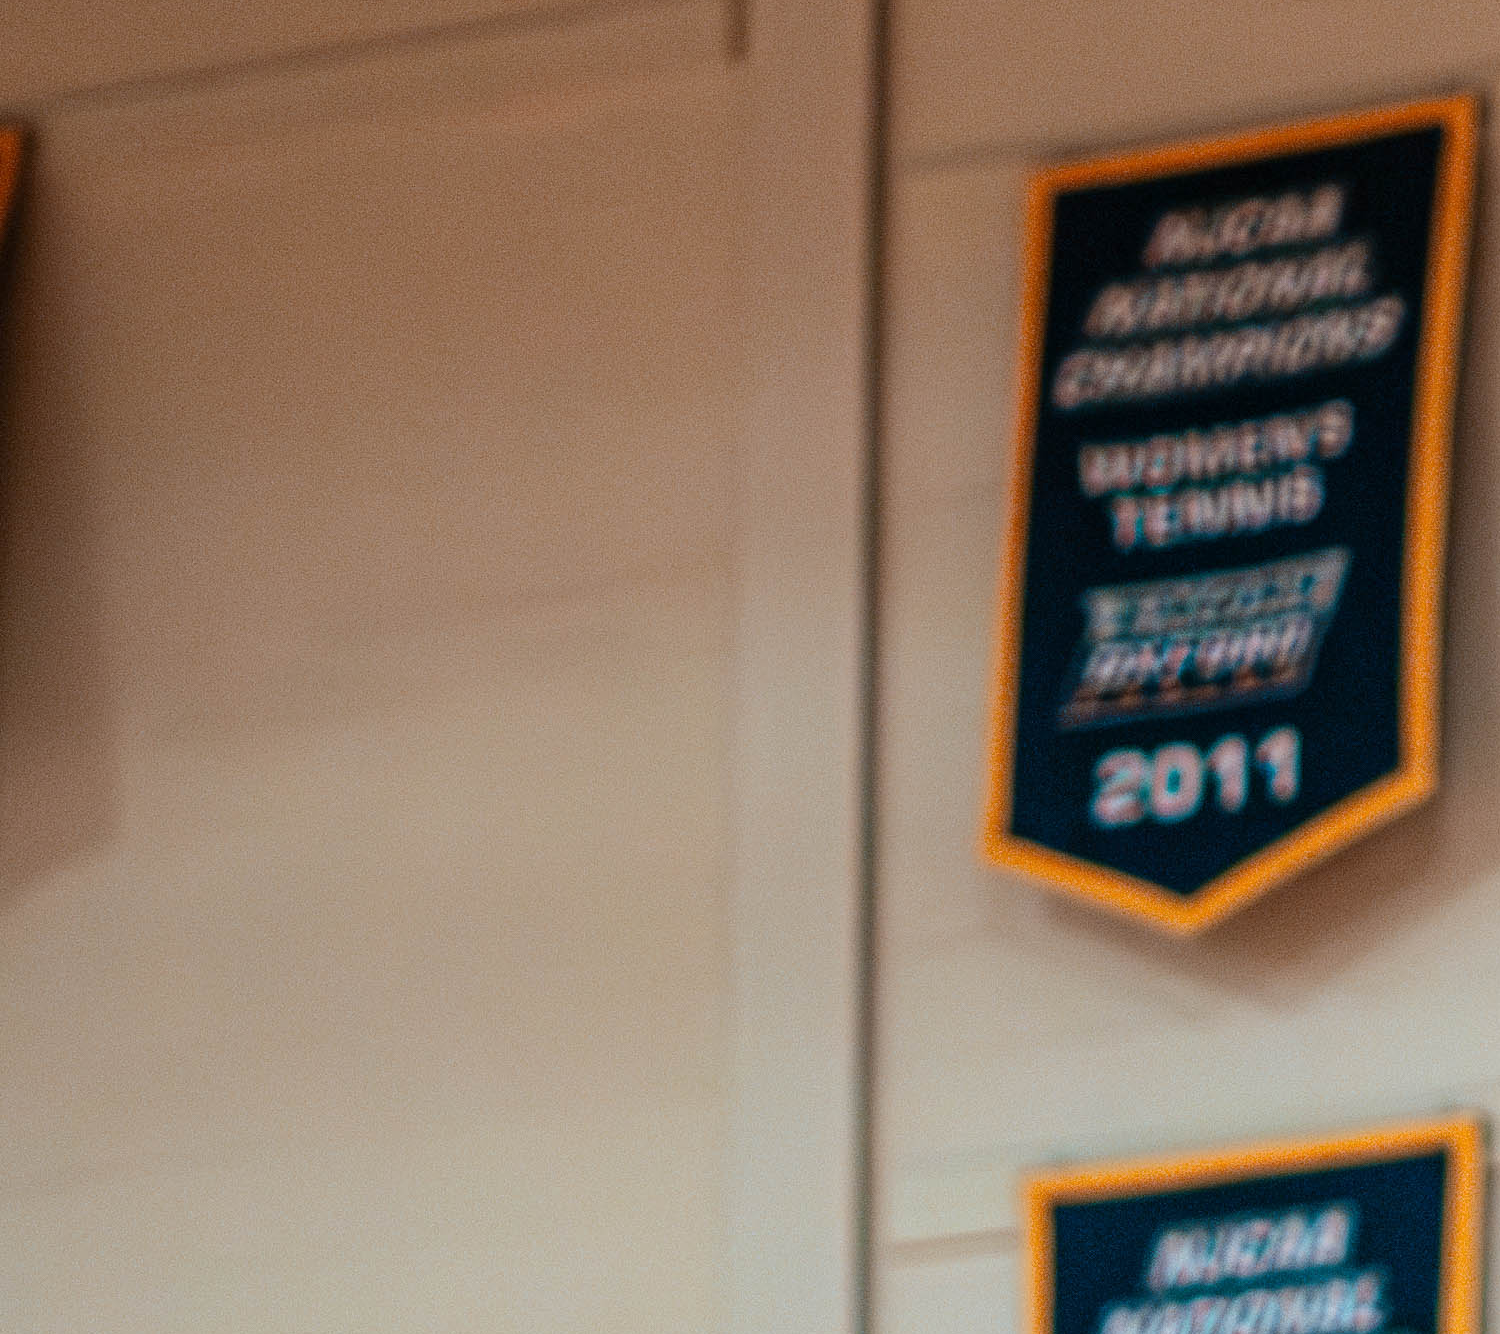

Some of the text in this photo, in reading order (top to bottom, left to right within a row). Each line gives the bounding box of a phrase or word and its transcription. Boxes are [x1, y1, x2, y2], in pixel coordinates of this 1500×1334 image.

[1058, 303, 1398, 405] CHAMPIONS
[1086, 406, 1347, 491] WOMEN'S
[1118, 471, 1317, 545] TENNIS
[1097, 732, 1297, 823] 2011
